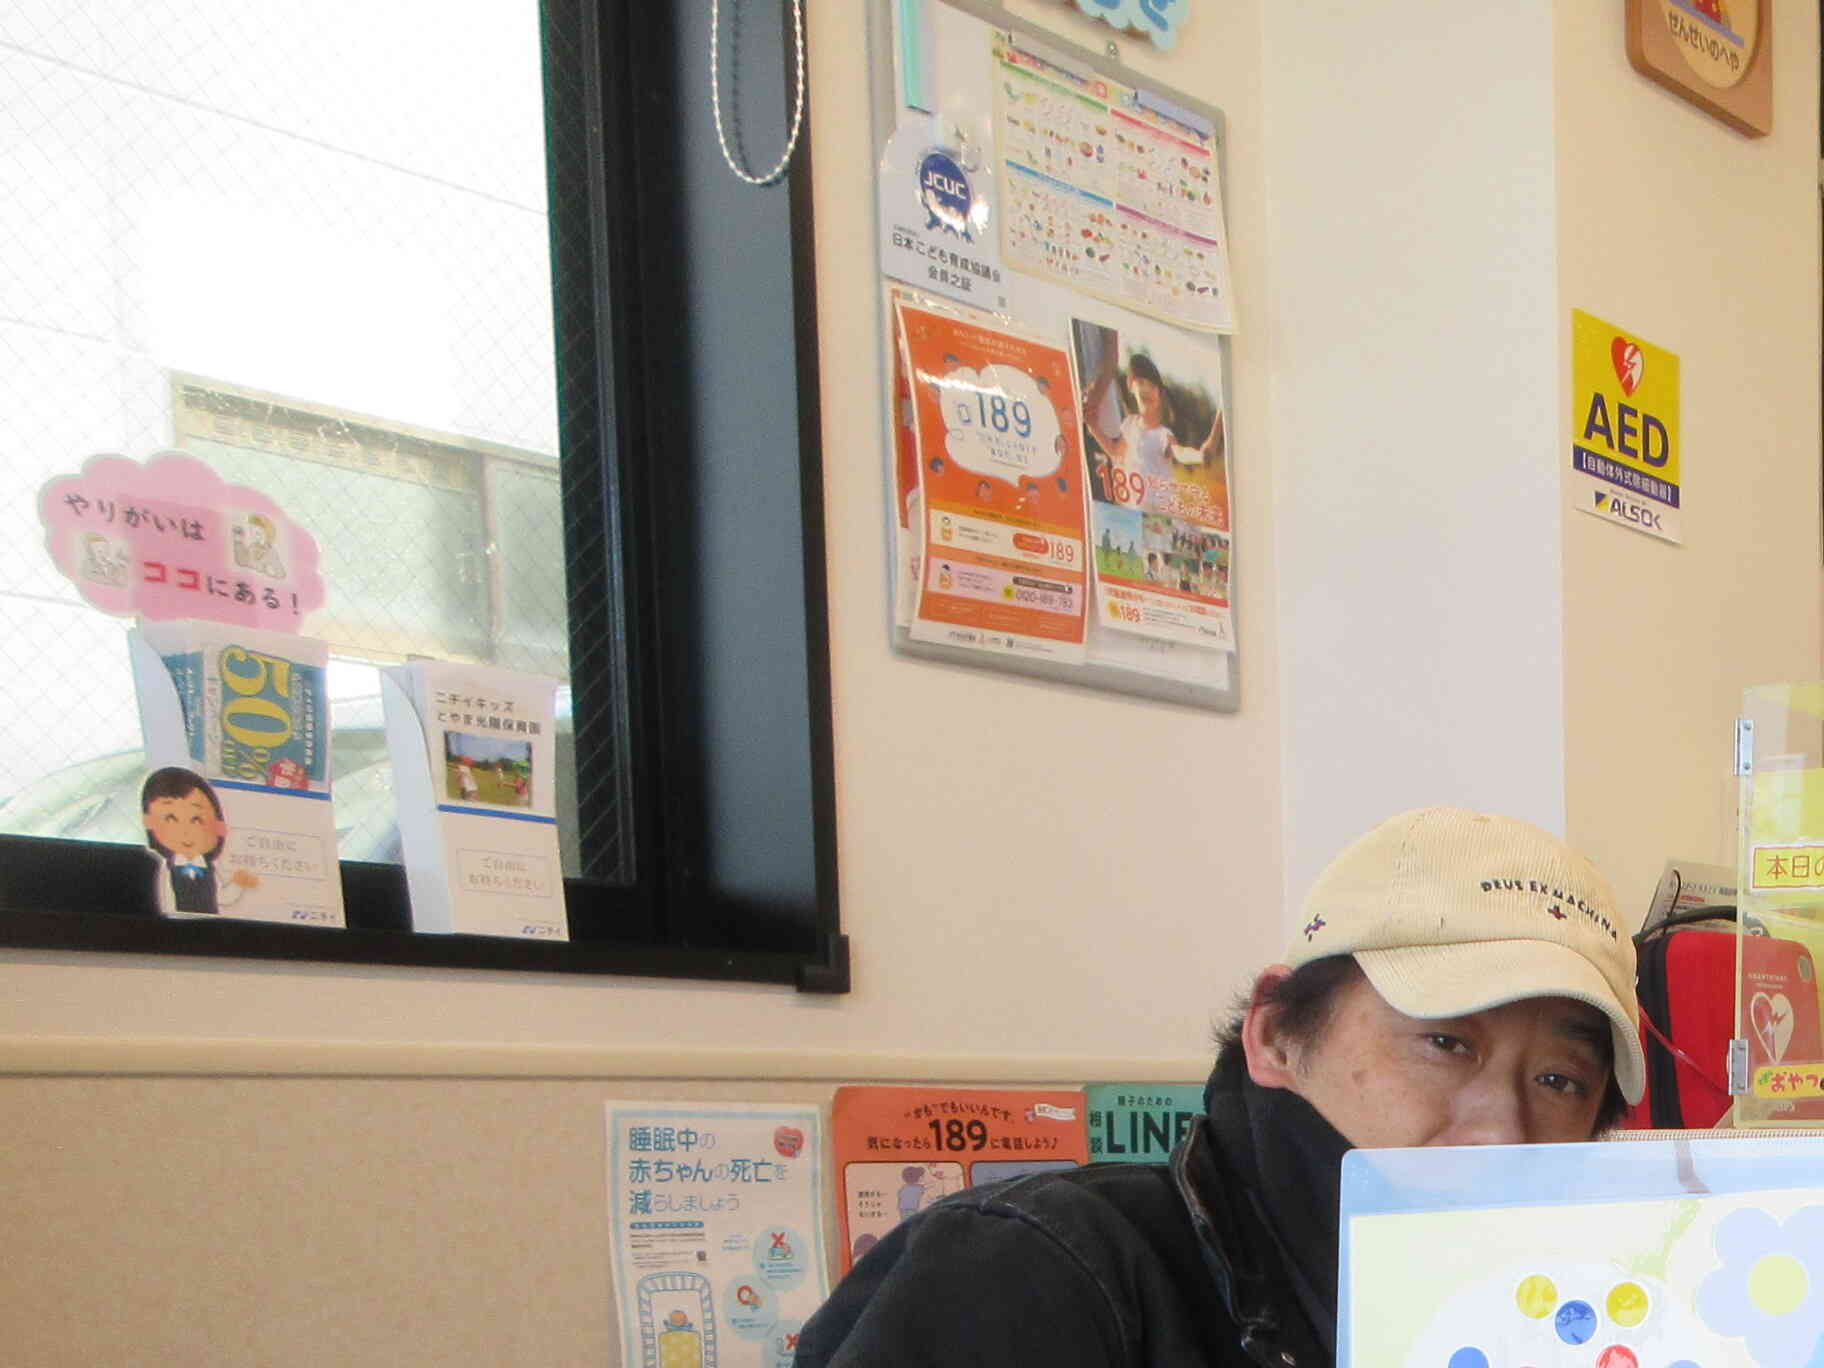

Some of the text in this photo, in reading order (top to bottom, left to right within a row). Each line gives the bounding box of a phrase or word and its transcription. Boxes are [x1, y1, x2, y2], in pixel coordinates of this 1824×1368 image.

[922, 171, 967, 200] JCUC
[976, 391, 1032, 438] 189
[1583, 392, 1670, 468] AED
[1096, 463, 1147, 506] 189
[64, 492, 206, 541] やりがいは
[1610, 498, 1663, 530] ALSOK
[1050, 542, 1075, 564] 189
[1119, 604, 1141, 625] 189
[435, 691, 515, 713] ニチイキッズ
[1529, 880, 1549, 895] EX
[1770, 1072, 1819, 1093] おやつ
[629, 1127, 717, 1152] 睡眠中の
[629, 1158, 788, 1183] 赤ちゃんの死亡を
[629, 1189, 741, 1215] 減らしましょう
